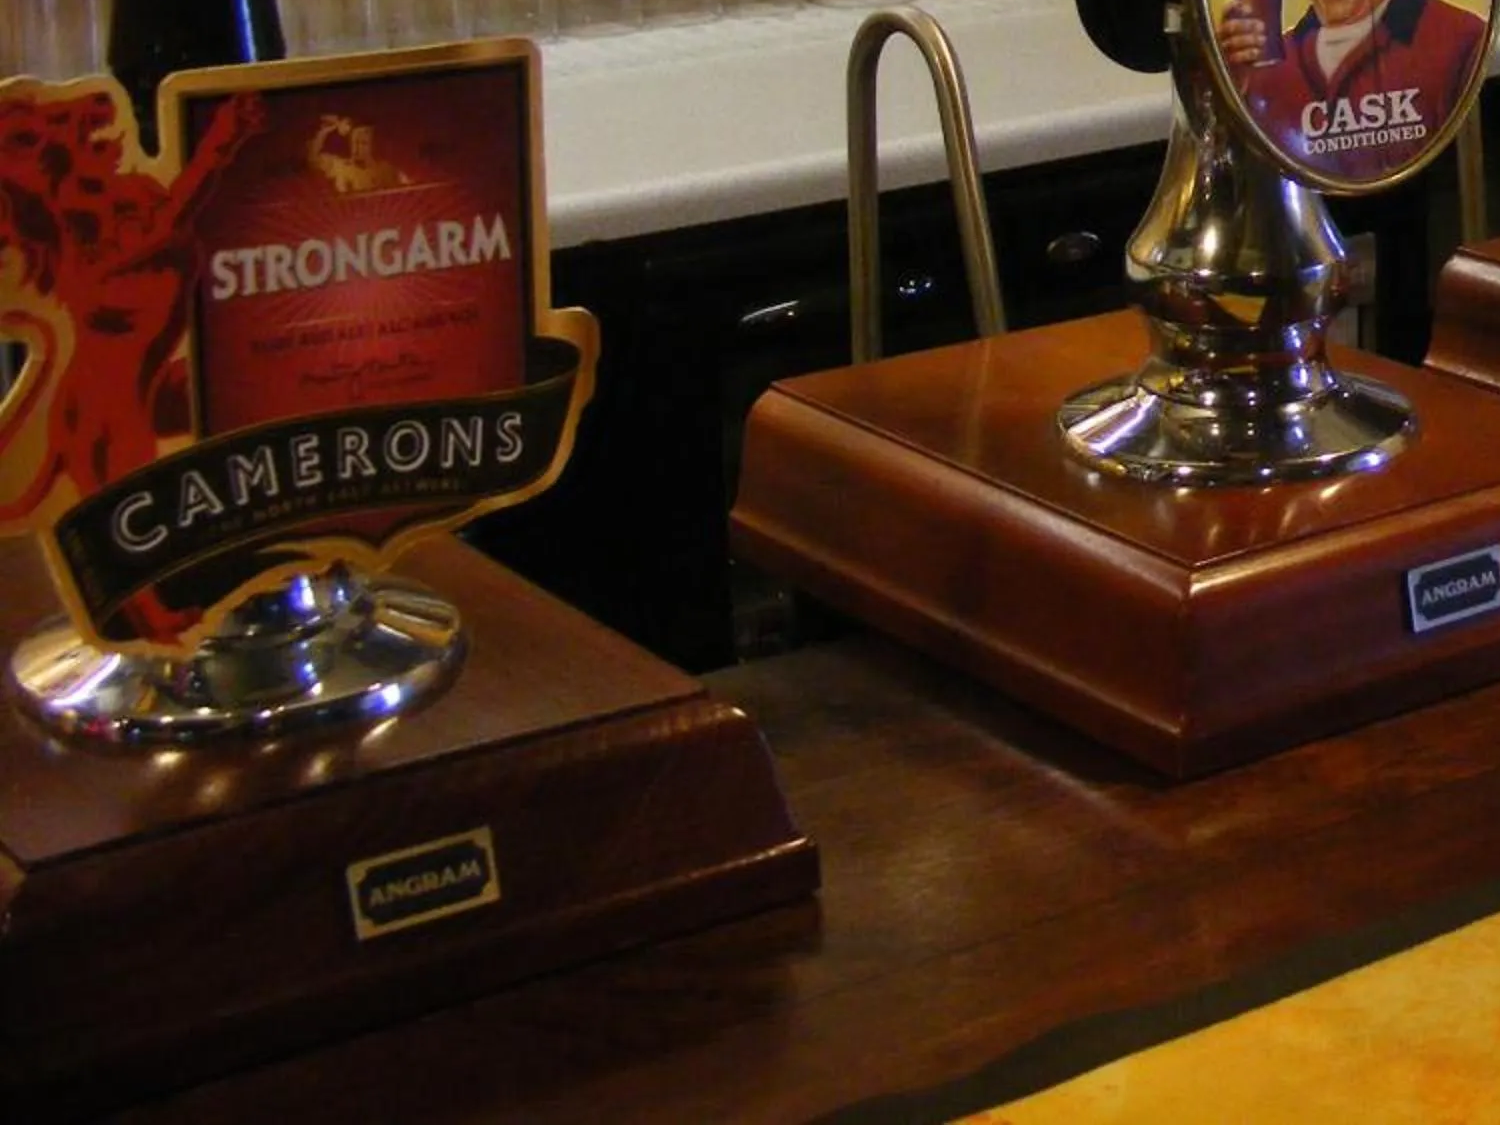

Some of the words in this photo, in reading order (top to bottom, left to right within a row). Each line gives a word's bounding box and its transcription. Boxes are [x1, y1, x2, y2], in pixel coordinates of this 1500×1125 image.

[1301, 87, 1423, 138] CASK
[1303, 123, 1428, 155] CONDITIONED
[211, 212, 512, 301] STRONGARM
[112, 411, 524, 553] CAMERONS
[1421, 570, 1497, 606] ANGRAM
[368, 859, 482, 909] ANGRAM
